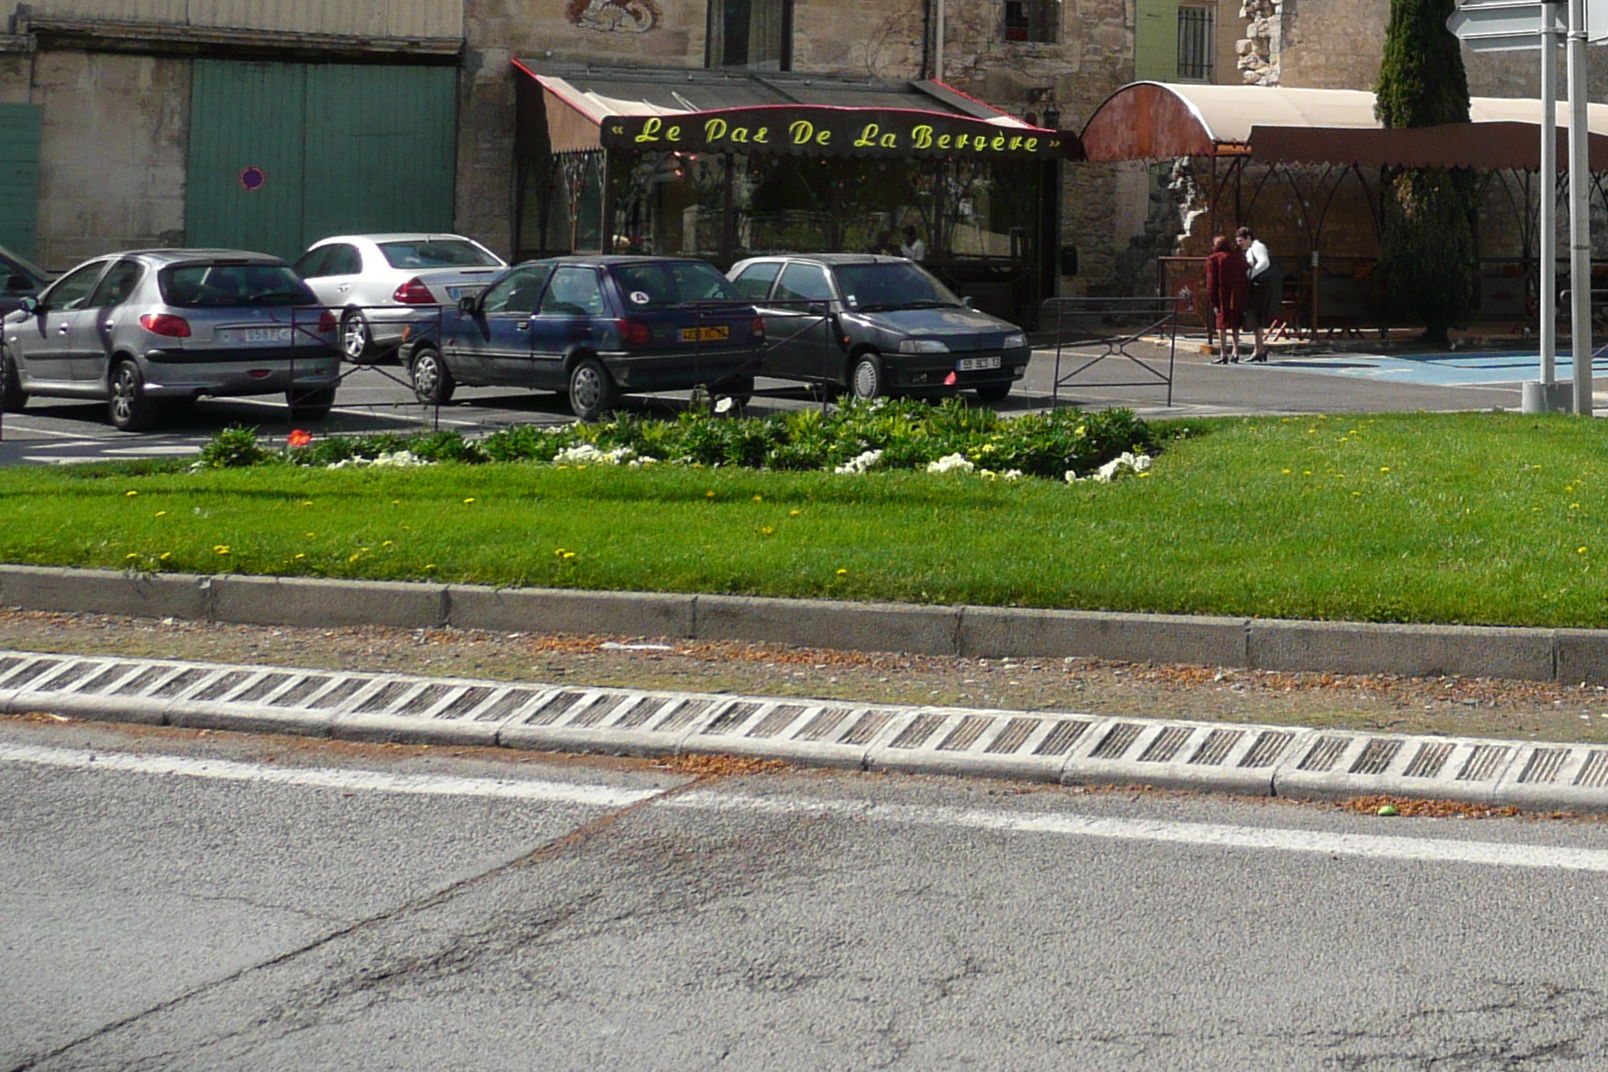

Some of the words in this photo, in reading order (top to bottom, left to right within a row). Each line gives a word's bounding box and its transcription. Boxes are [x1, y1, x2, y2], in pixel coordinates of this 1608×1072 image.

[634, 117, 681, 143] Le
[704, 118, 768, 144] Pas
[789, 120, 832, 146] De
[853, 123, 897, 149] La
[911, 125, 1038, 152] Bergère
